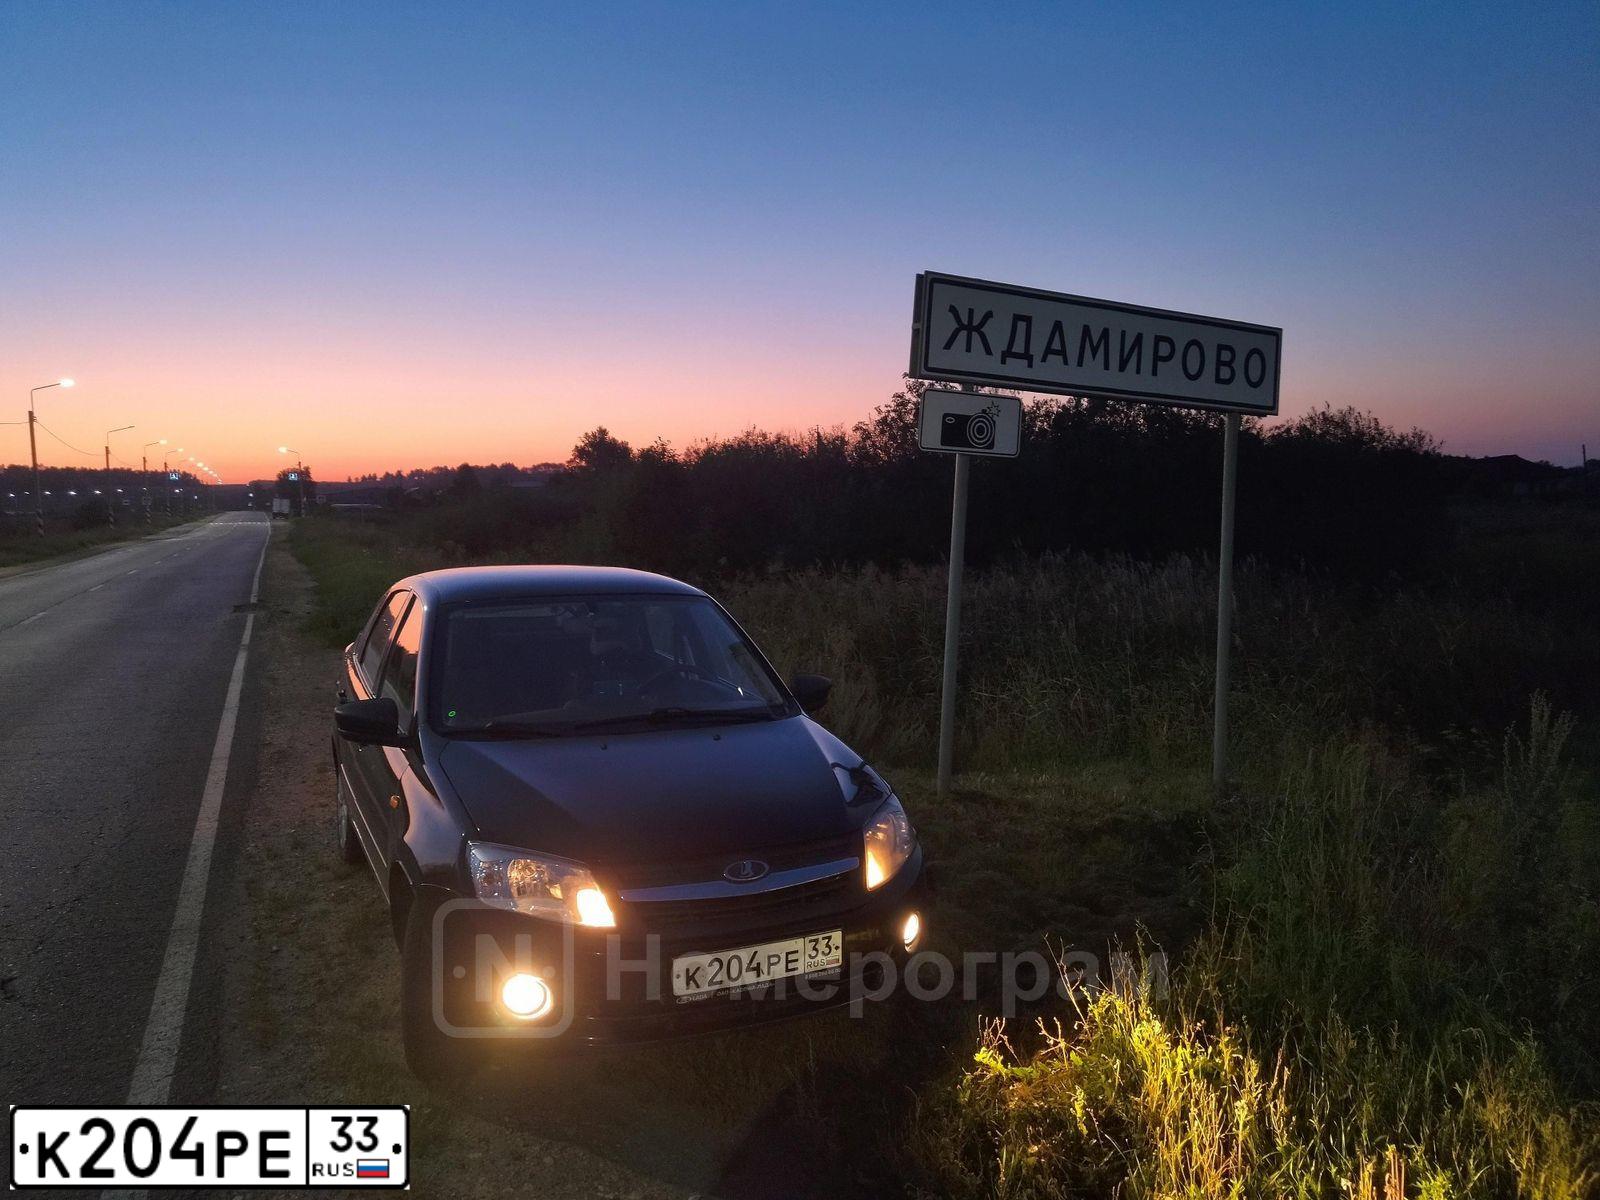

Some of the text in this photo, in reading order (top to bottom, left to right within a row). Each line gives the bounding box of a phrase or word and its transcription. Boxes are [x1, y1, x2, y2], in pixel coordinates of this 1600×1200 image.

[943, 304, 1266, 389] ЖДАМИРОВО
[685, 950, 799, 990] К204РЕ
[808, 935, 833, 960] 33
[806, 958, 826, 969] RUS
